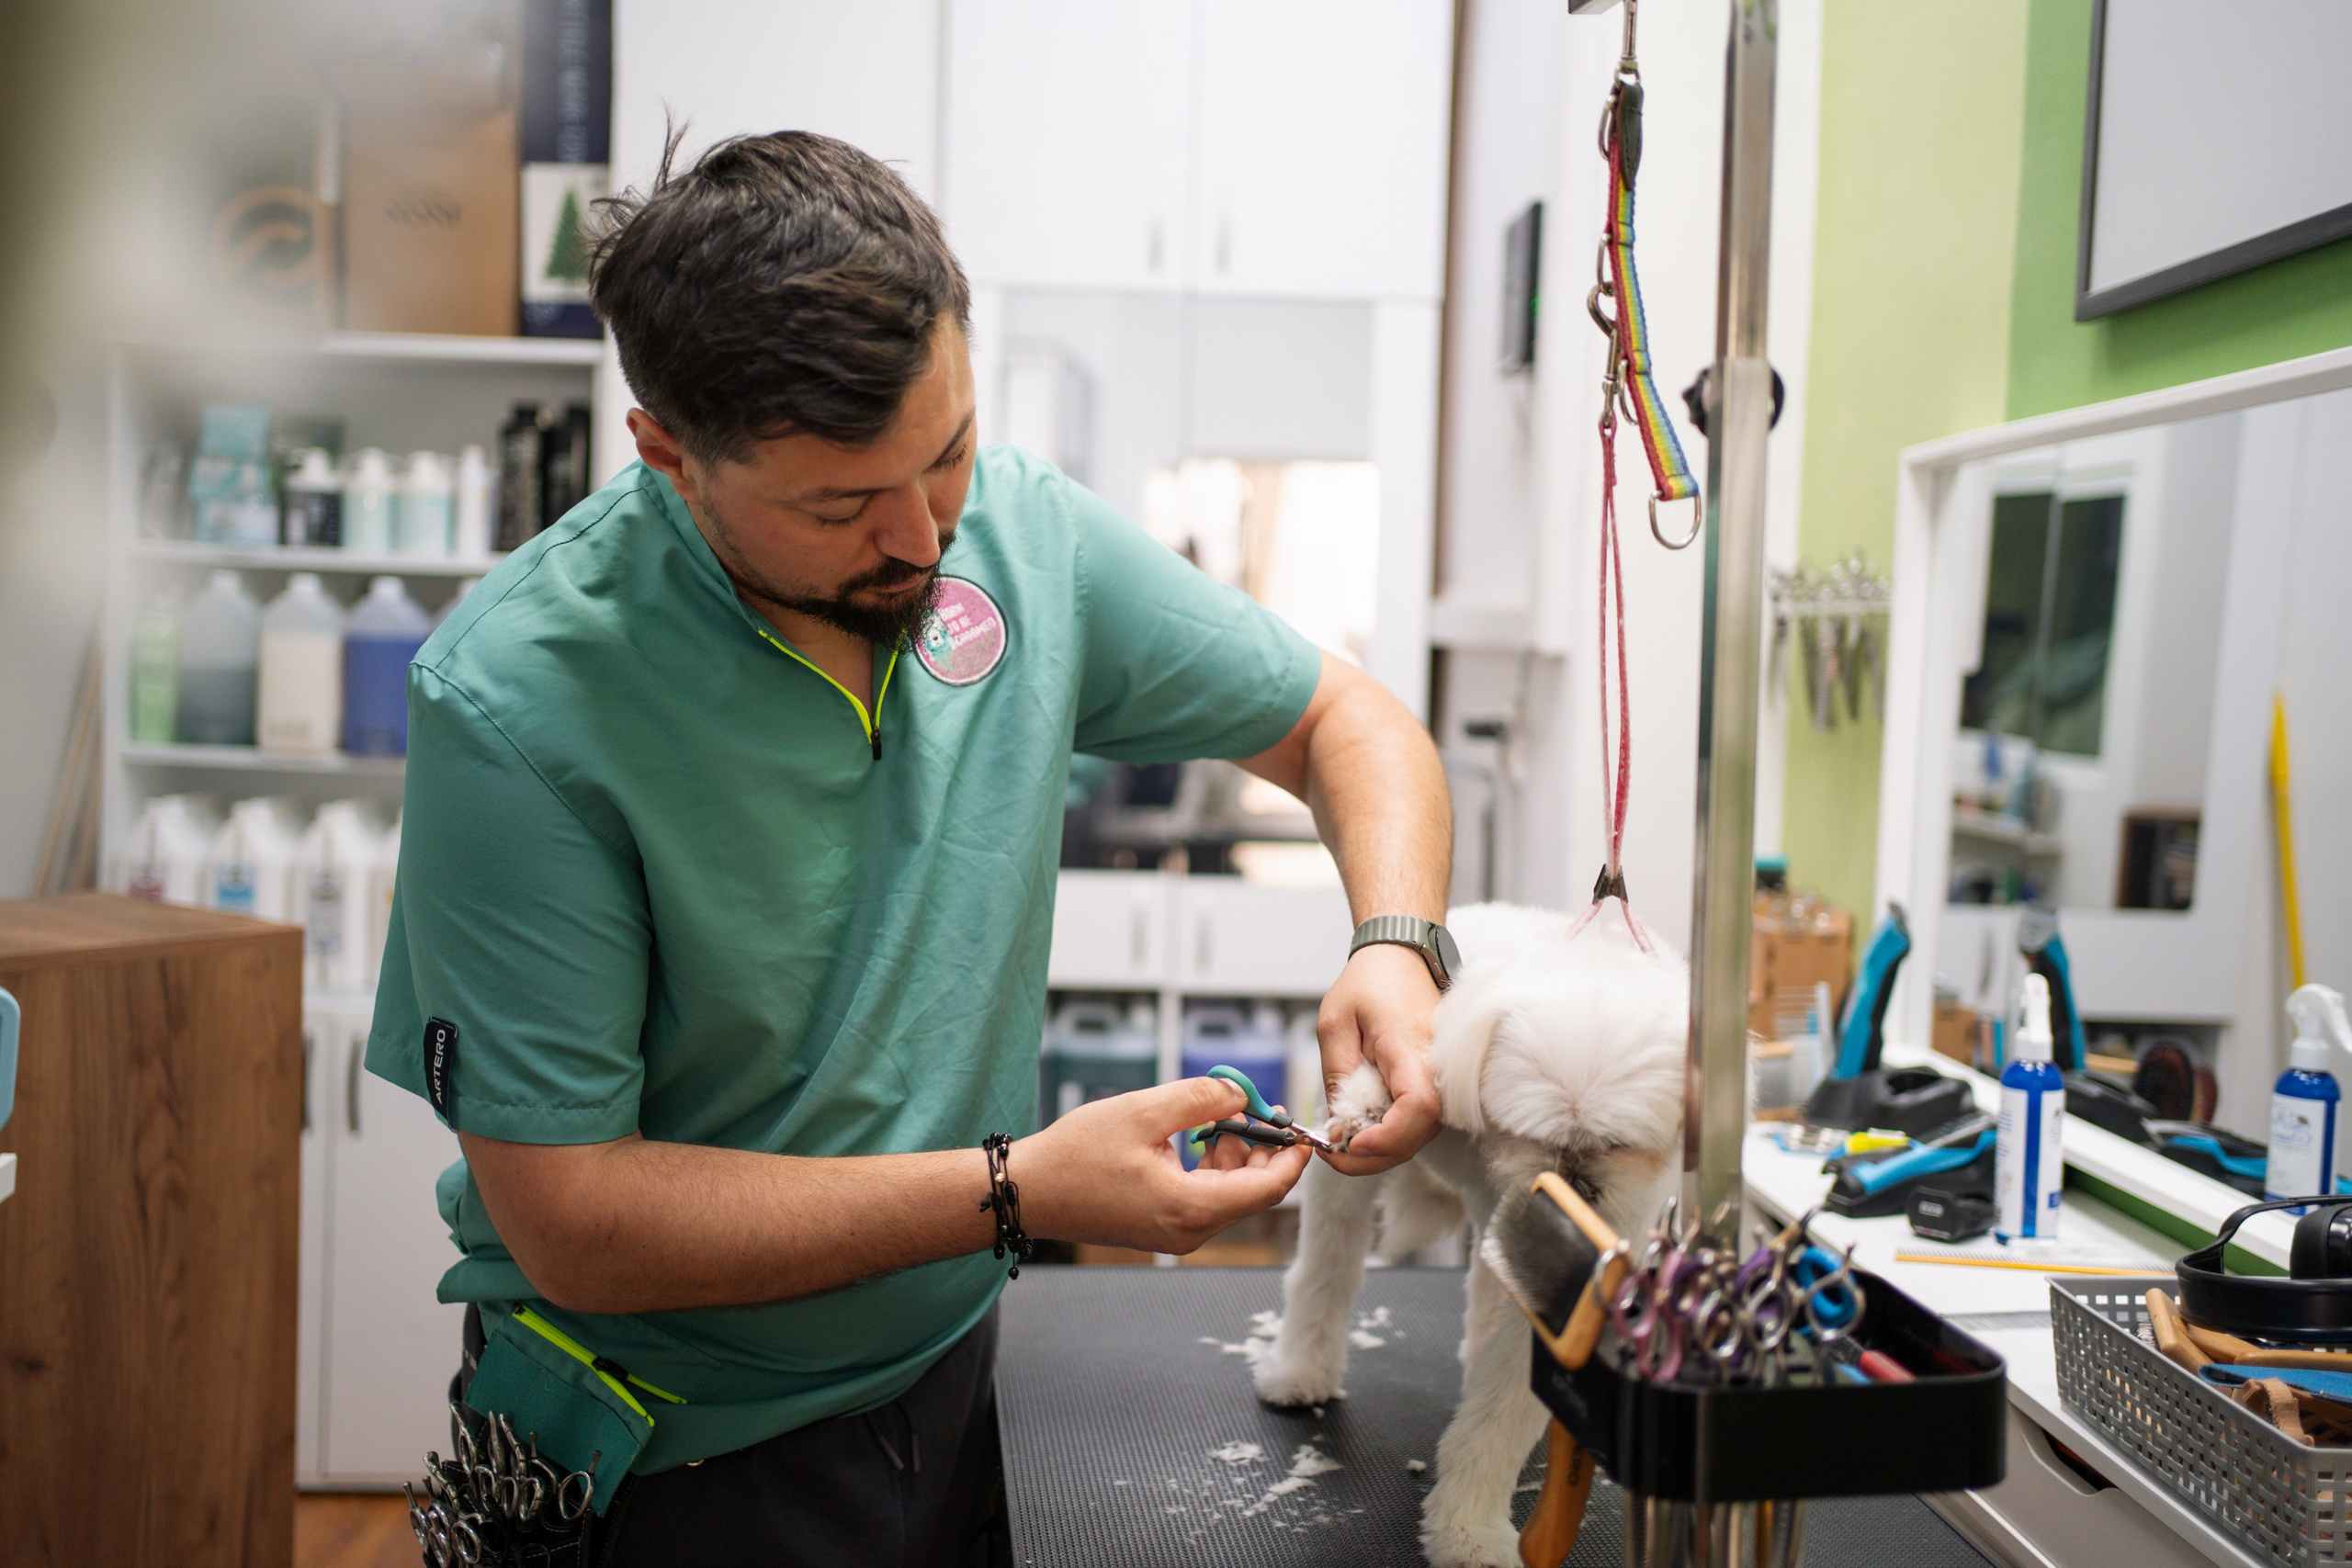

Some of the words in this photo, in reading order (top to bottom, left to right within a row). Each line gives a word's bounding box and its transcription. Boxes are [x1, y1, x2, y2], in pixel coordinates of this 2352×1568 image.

[938, 603, 965, 622] BORN
[958, 615, 973, 628] BE
[434, 1029, 446, 1105] ARTERO
